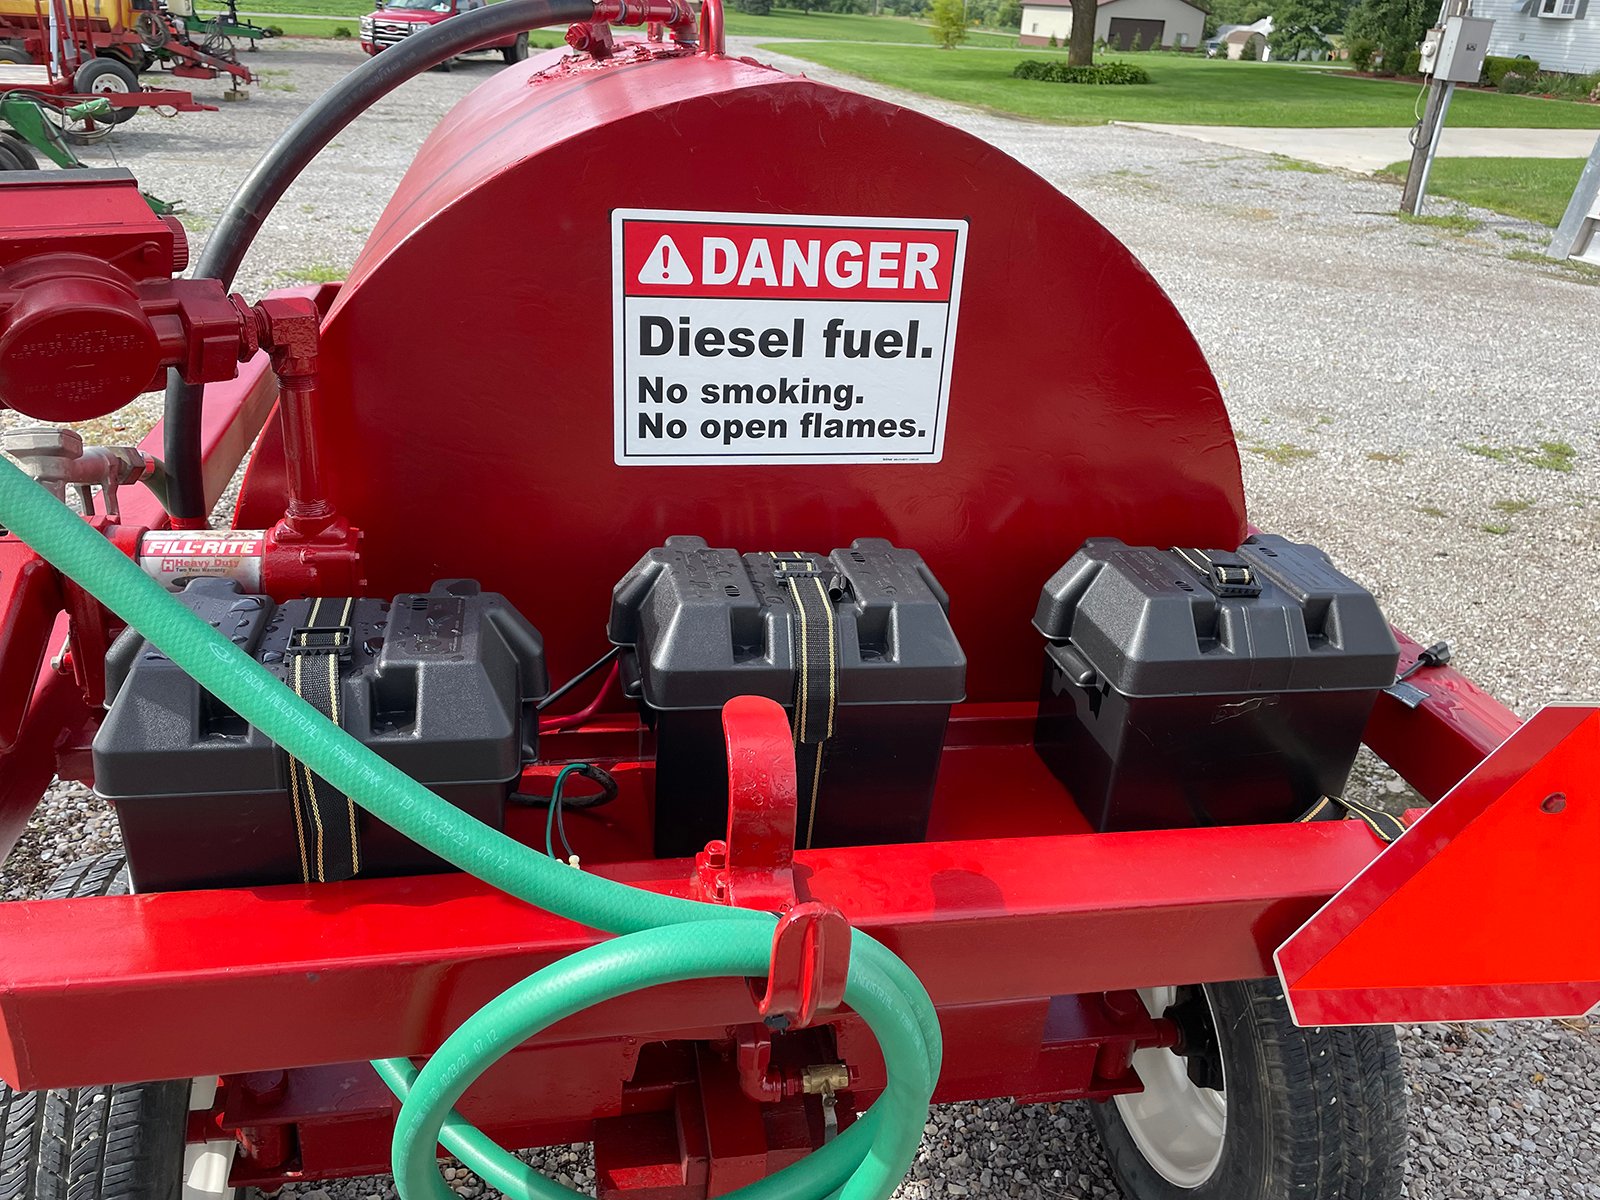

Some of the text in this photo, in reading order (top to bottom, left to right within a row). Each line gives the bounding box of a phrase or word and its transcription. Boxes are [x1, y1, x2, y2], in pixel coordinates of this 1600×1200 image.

[702, 236, 940, 290] DANGER
[638, 315, 933, 359] Diesel fuel.
[637, 376, 865, 410] No smoking.
[637, 412, 927, 445] No open flames.
[146, 540, 257, 554] FILL-RITE
[175, 558, 210, 568] Heavy
[214, 558, 240, 568] Duty
[234, 665, 268, 693] JASON
[265, 689, 321, 742] INDUSTRIAL
[329, 743, 358, 769] FARM
[357, 762, 385, 788] TANK
